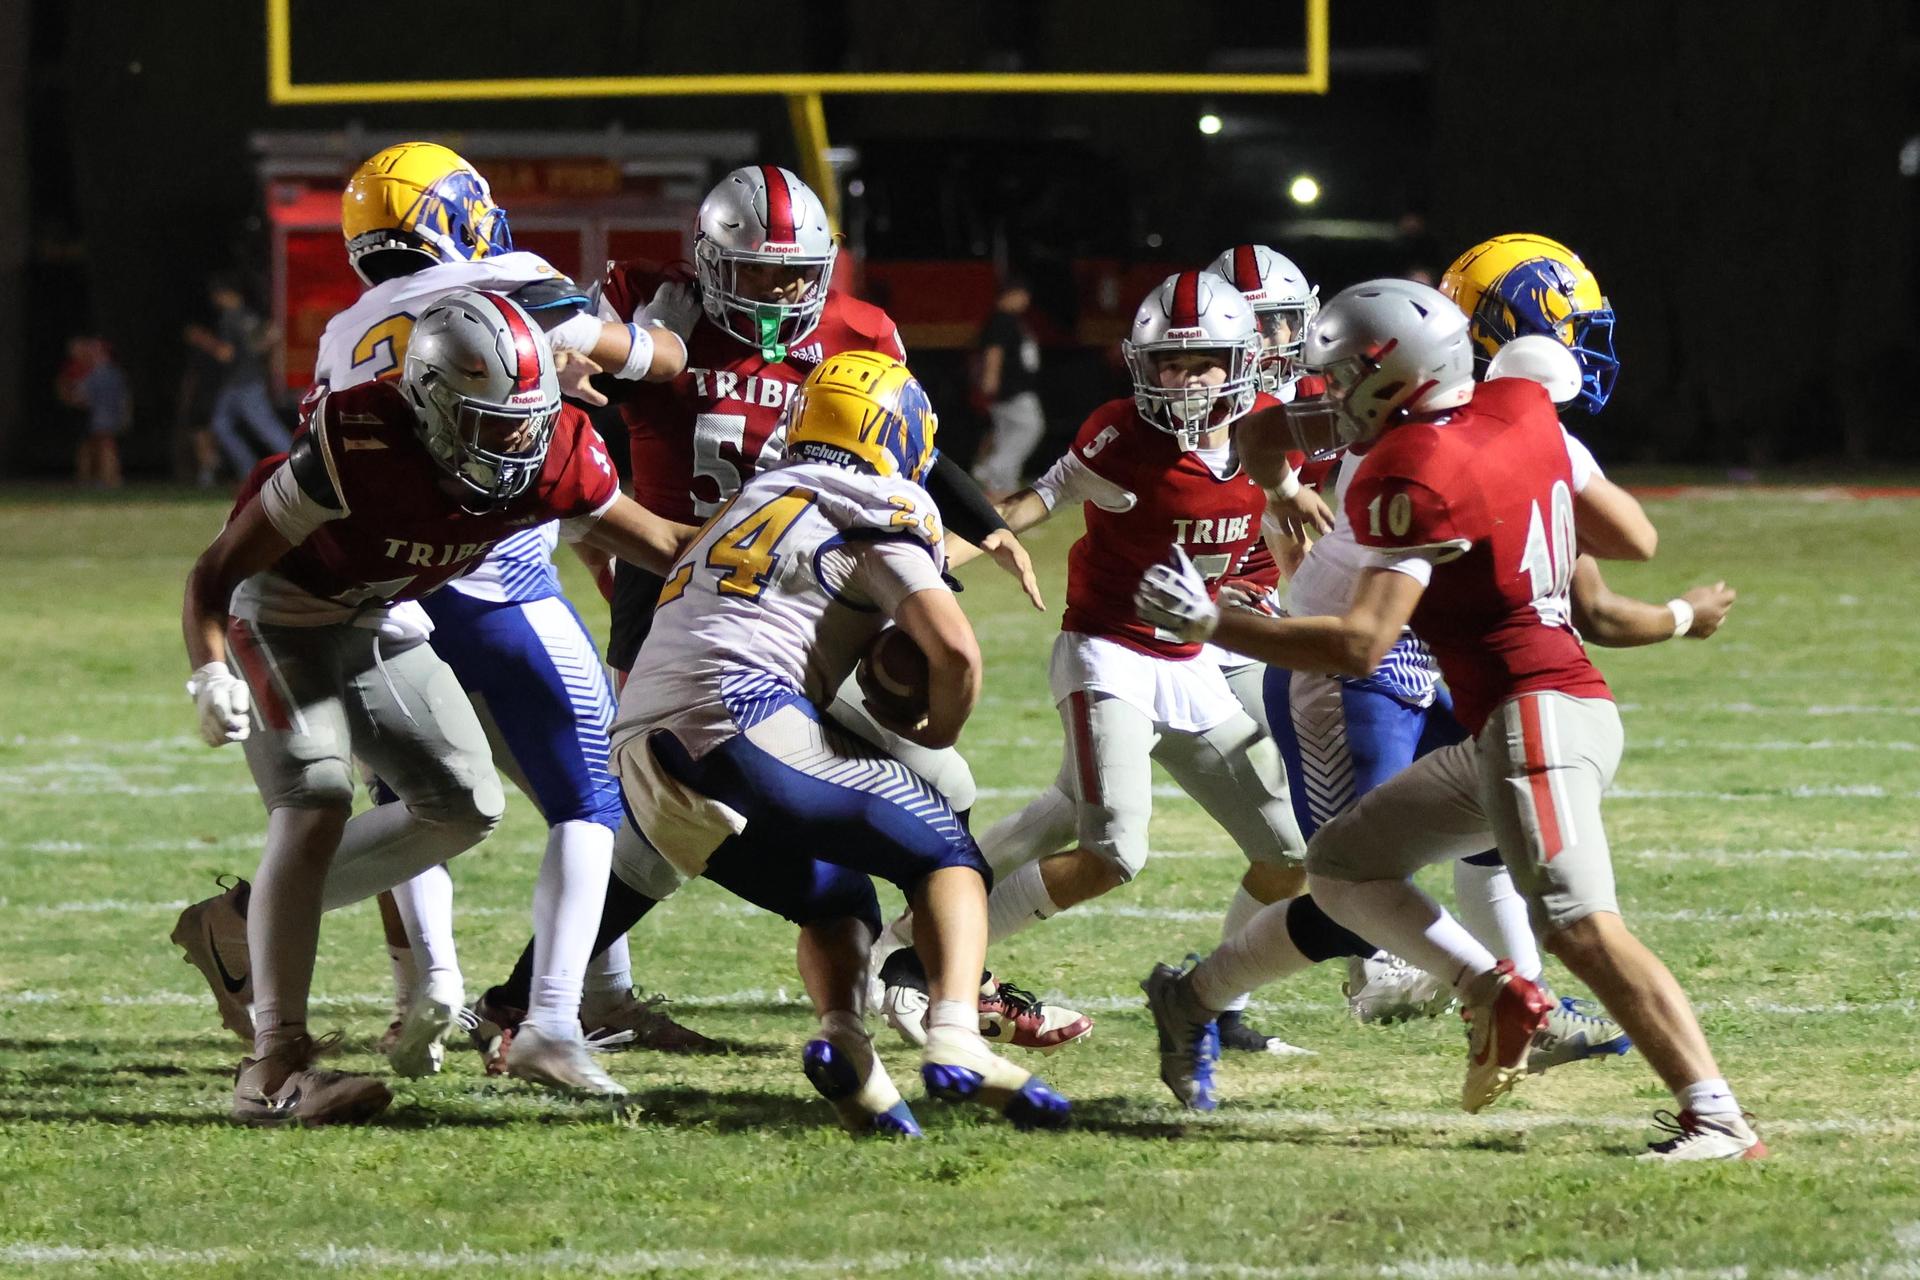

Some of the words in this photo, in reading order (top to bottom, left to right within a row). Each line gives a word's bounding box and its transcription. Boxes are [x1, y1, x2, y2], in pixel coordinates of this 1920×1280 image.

[764, 245, 800, 254] Riddell
[1167, 330, 1202, 340] Riddell
[791, 350, 823, 365] adida
[803, 444, 852, 465] schutt
[1082, 424, 1121, 459] 5
[1366, 492, 1412, 537] 10
[1172, 513, 1253, 545] TRIBE
[1518, 479, 1577, 628] 10
